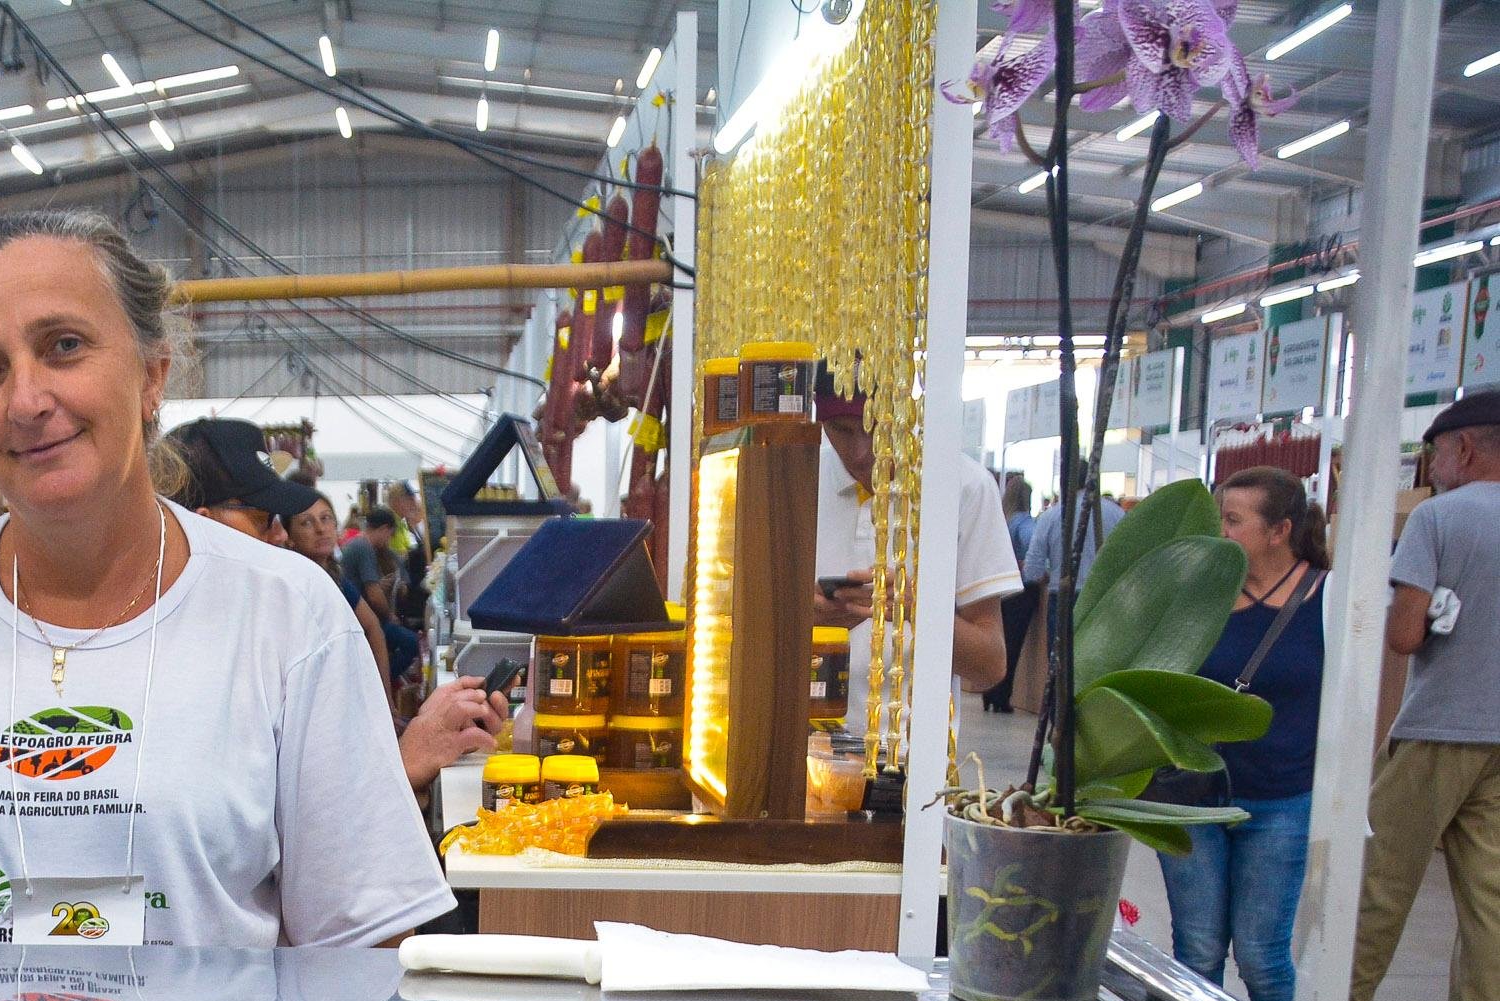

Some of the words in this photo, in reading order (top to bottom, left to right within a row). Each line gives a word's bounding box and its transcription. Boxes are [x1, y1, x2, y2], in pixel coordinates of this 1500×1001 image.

[0, 733, 74, 749] EXPOAGRO
[77, 732, 132, 747] AFUBRA
[34, 791, 63, 802] FEIRA
[66, 791, 81, 801] DO
[83, 788, 119, 800] BRASIL
[19, 806, 90, 817] AGRICULTURA
